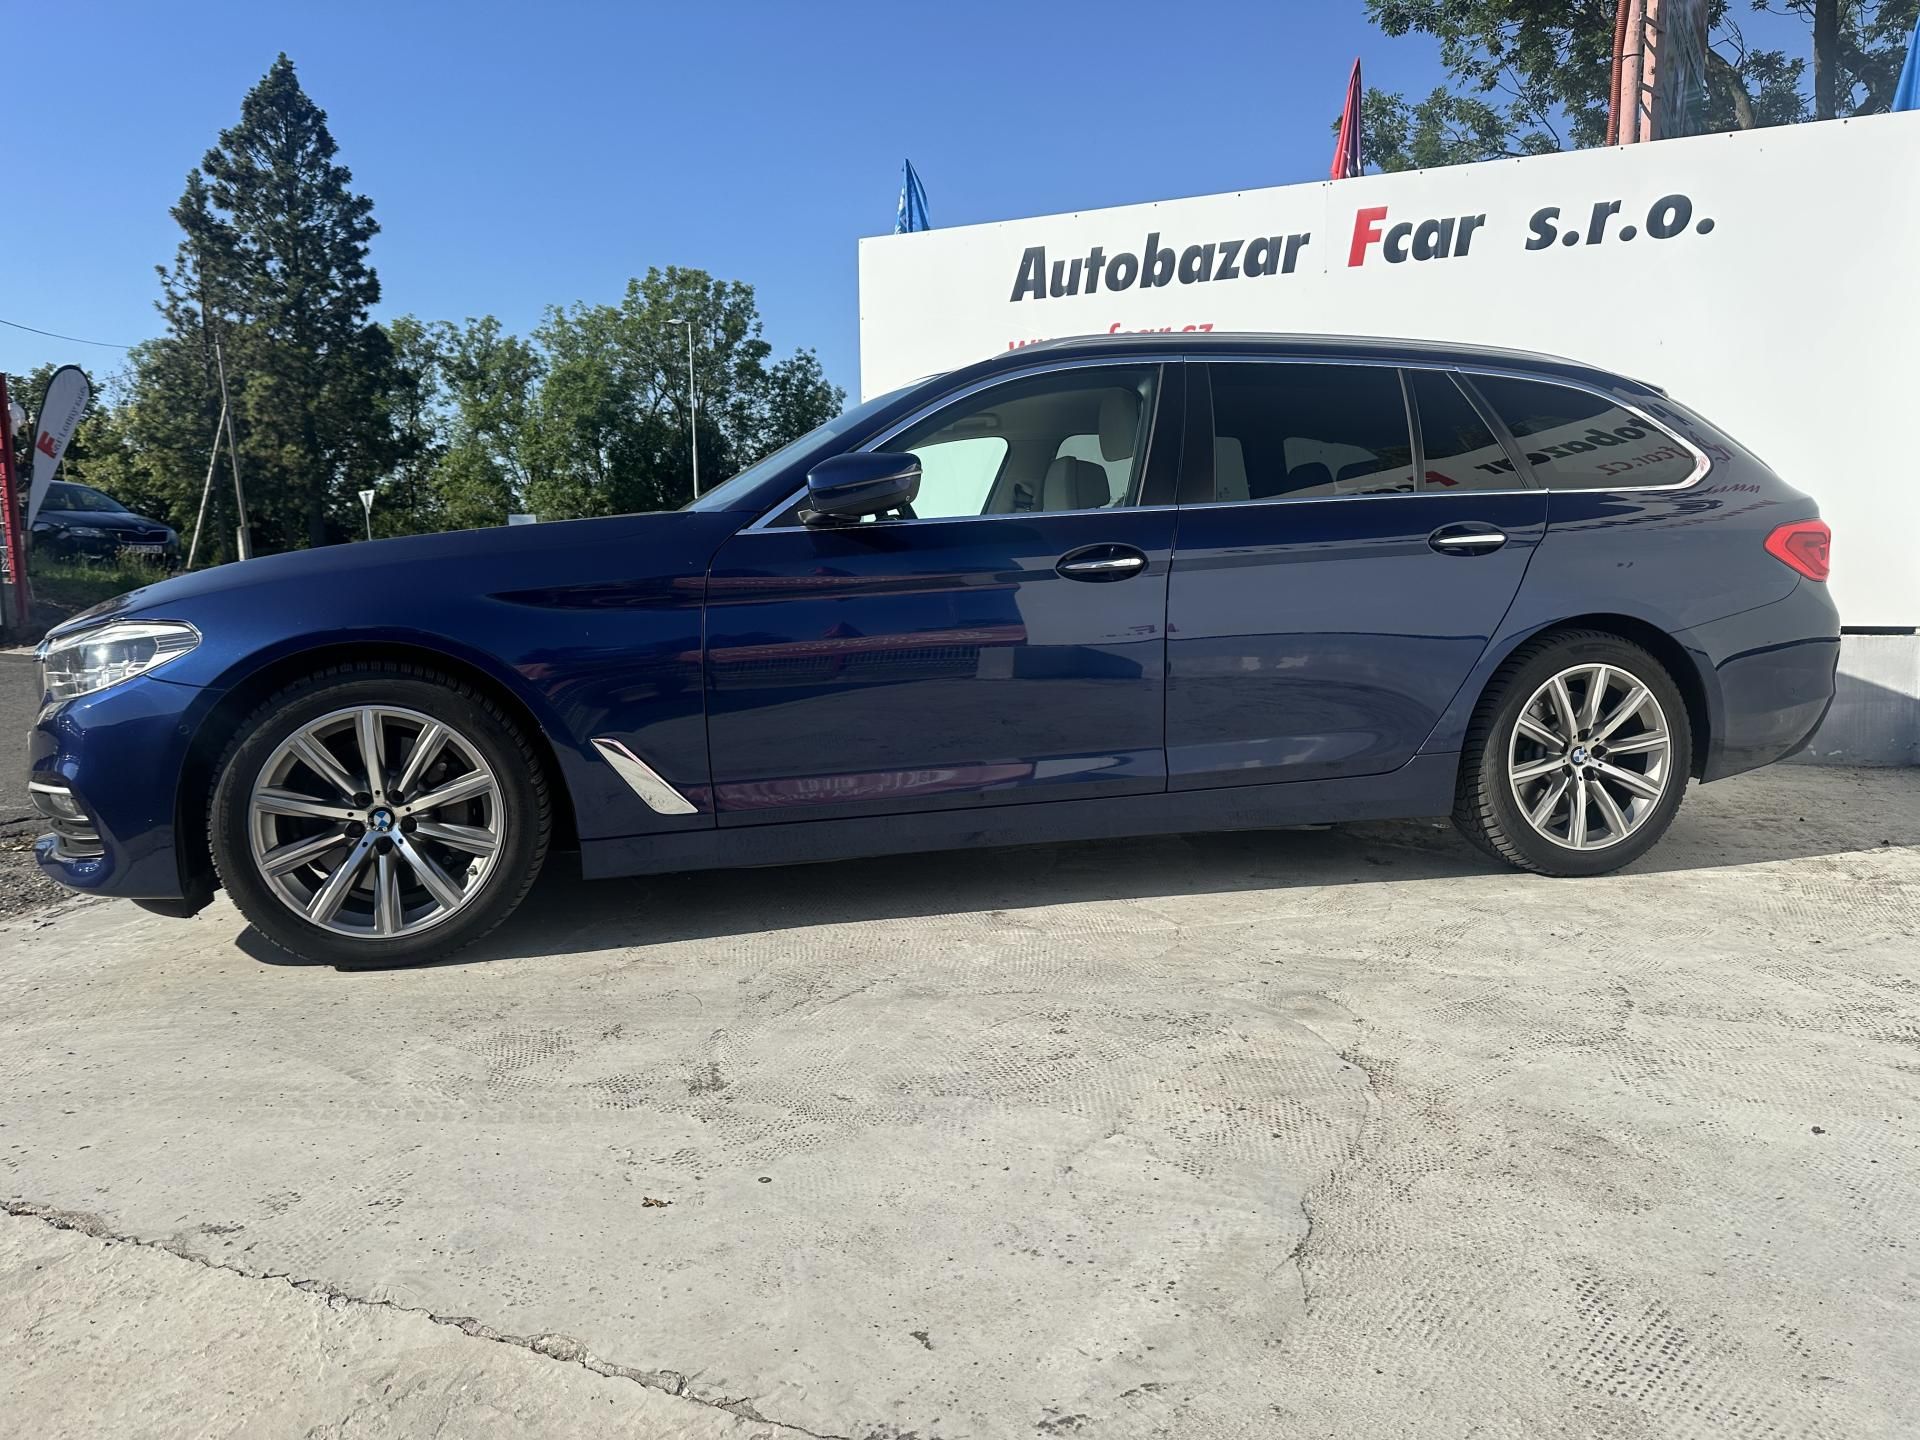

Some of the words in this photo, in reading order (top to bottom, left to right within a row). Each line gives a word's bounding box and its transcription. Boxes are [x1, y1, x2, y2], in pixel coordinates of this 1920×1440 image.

[1010, 229, 1310, 302] Autobazar
[1348, 206, 1486, 267] Fcar
[1525, 194, 1715, 251] s.r.o.
